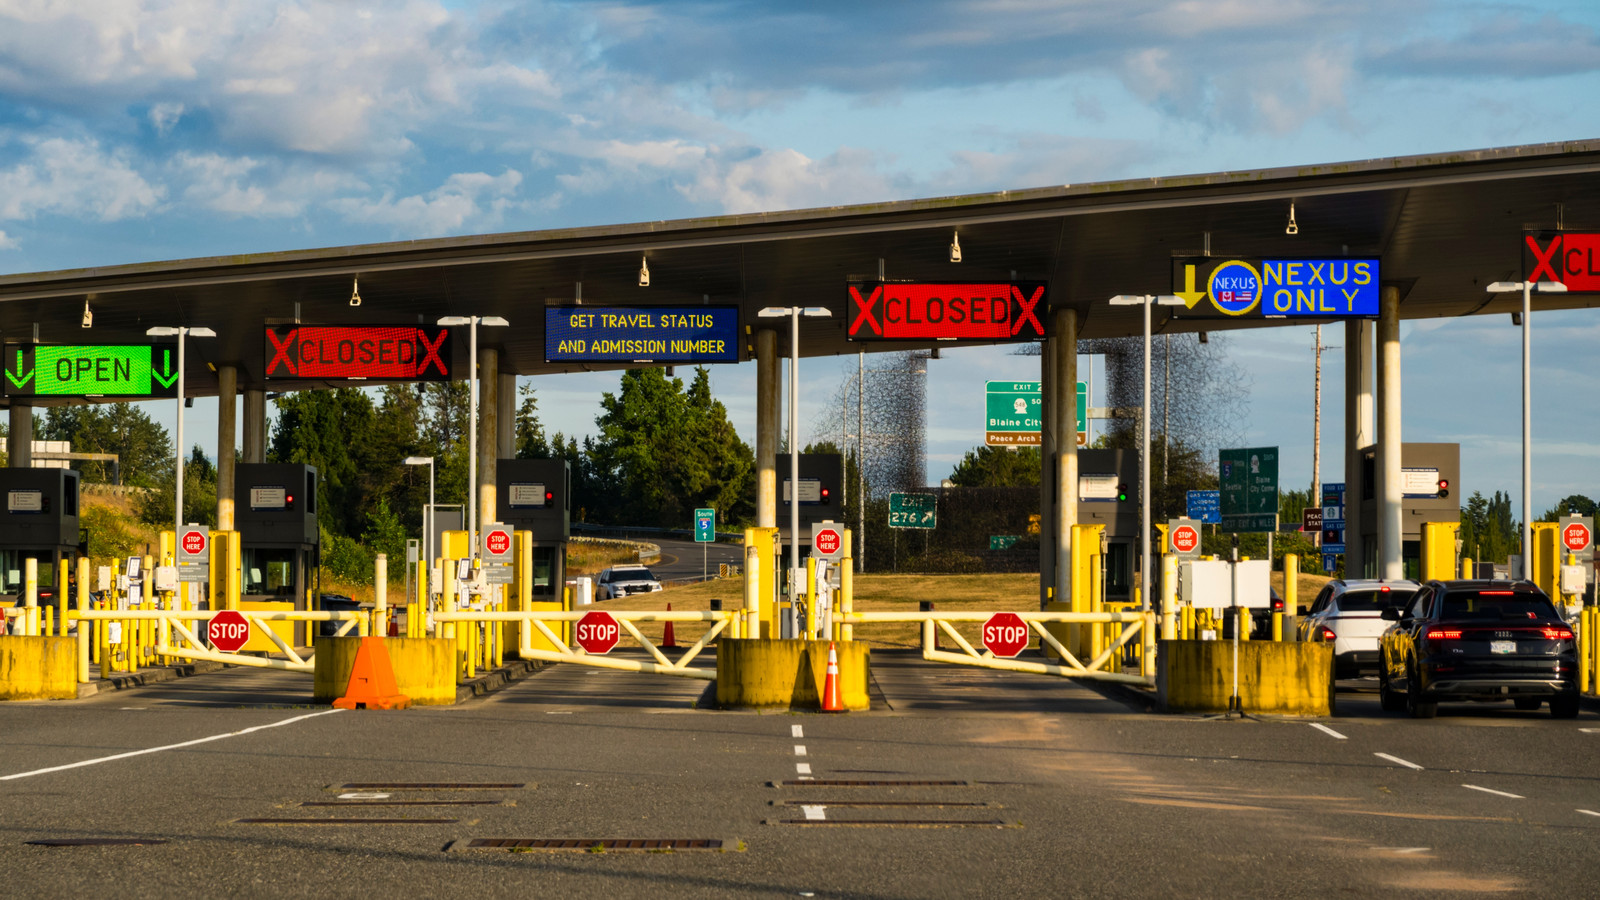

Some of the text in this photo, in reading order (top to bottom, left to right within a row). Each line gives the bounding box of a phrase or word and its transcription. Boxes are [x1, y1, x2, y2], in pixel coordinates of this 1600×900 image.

[1263, 262, 1371, 286] NEXUS
[1215, 277, 1256, 290] NEXUS
[1273, 288, 1359, 312] ONLY
[885, 297, 1009, 324] CLOSED
[569, 314, 714, 328] GET TRAVEL STATUS
[300, 339, 415, 365] CLOSED
[558, 339, 726, 354] AND ADMISSION NUMBER
[56, 357, 131, 382] OPEN
[989, 418, 1021, 427] Blaine
[1017, 434, 1036, 442] Arch
[891, 512, 917, 523] 276
[702, 520, 708, 530] 5
[491, 535, 506, 543] STOP
[820, 534, 836, 542] STOP
[1178, 531, 1193, 539] STOP
[1569, 529, 1585, 537] STOP
[820, 542, 836, 550] HERE
[1177, 539, 1193, 547] HERE
[1569, 537, 1585, 545] HERE
[210, 622, 247, 639] STOP
[578, 624, 617, 641] STOP
[985, 625, 1026, 644] STOP
